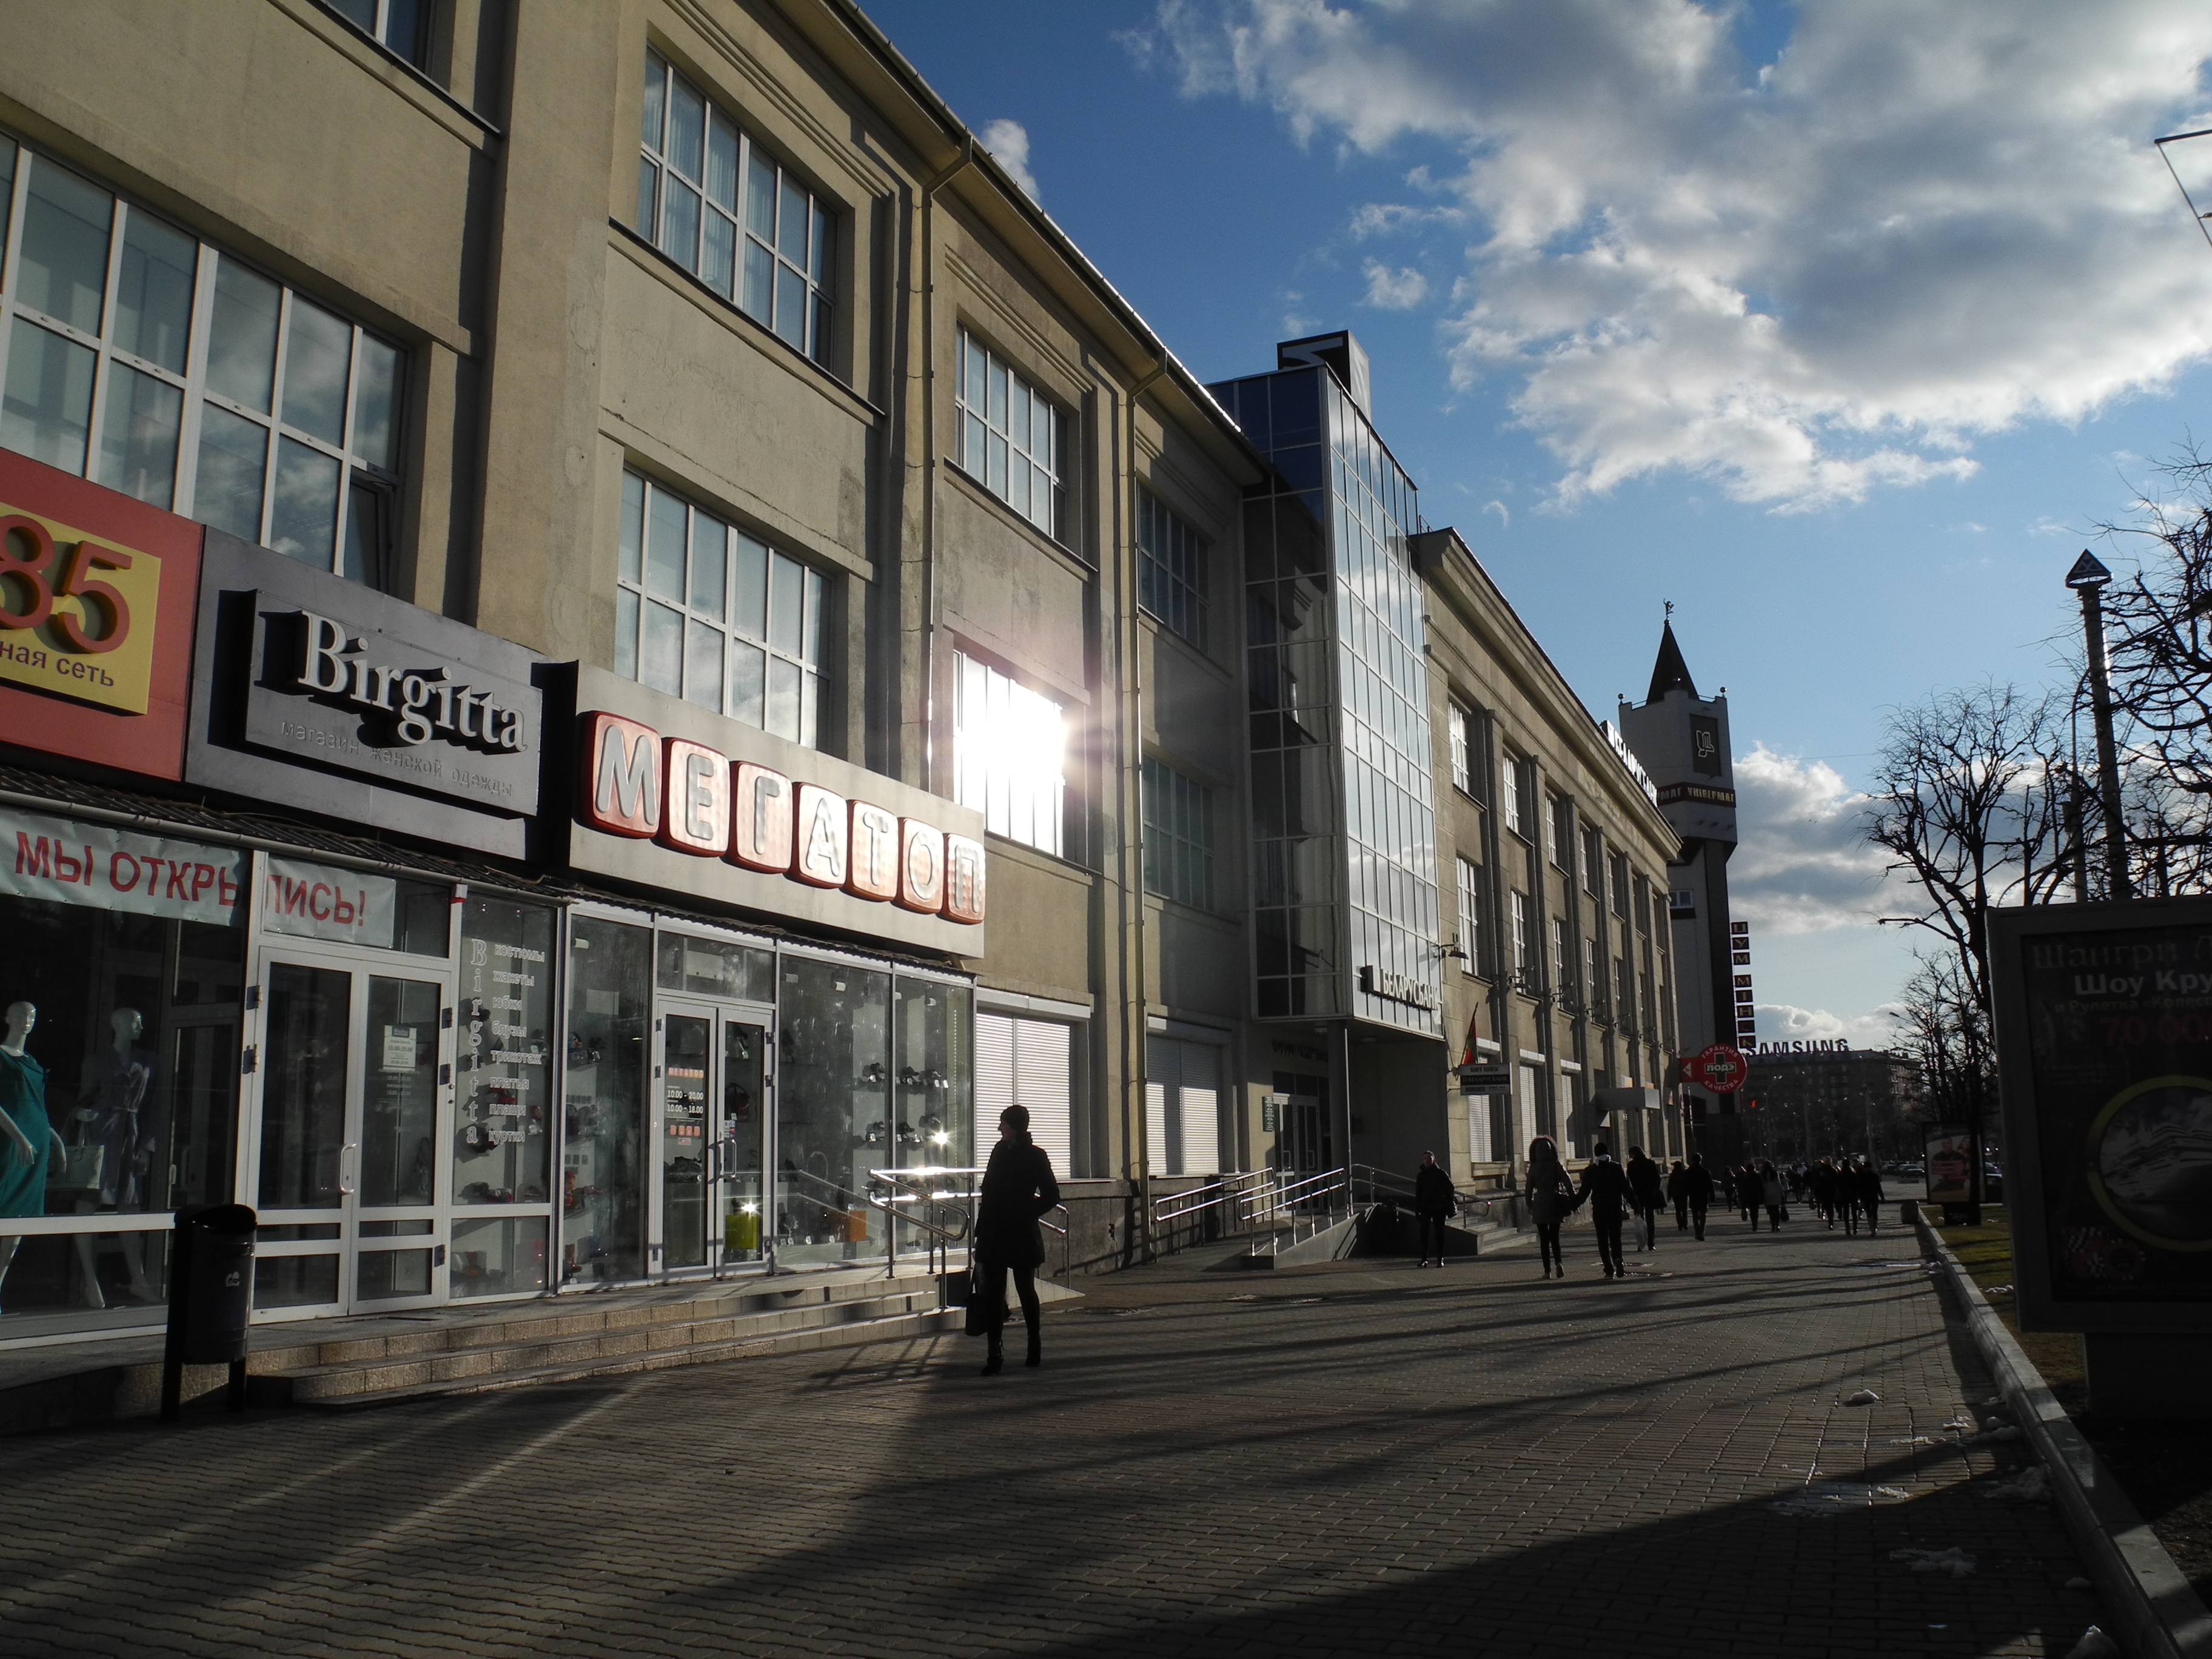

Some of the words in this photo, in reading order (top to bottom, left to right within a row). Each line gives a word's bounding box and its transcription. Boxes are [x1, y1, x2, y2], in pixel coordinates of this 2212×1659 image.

[0, 514, 132, 653] 85
[56, 657, 114, 687] сеть
[298, 609, 528, 752] Birgitta
[282, 720, 360, 756] магазин
[370, 746, 443, 778] женской
[451, 768, 512, 797] одежды
[1687, 786, 1735, 803] УНІВЕРМАГ
[595, 723, 980, 914] МЕГАТОП
[15, 831, 92, 886] МЫ
[1733, 923, 1749, 963] ЦУМ
[494, 943, 545, 963] костюмы
[2033, 943, 2177, 970] Шангри
[492, 971, 535, 987] жакеты
[2074, 973, 2145, 997] Шоу
[1382, 970, 1439, 1011] БЕЛАРУСБАНК
[492, 995, 522, 1011] юбки
[2068, 1000, 2139, 1016] Рулетка
[491, 1020, 528, 1039] блузы
[2097, 1015, 2147, 1047] 70
[466, 938, 488, 1144] Birgitta
[1744, 1038, 1849, 1057] SAMSUNG
[490, 1050, 542, 1065] трикотаж
[1701, 1045, 1738, 1059] ГАРАНТИЯ
[668, 1067, 704, 1079] МЕГАТОП
[489, 1077, 530, 1090] платья
[1704, 1079, 1738, 1091] КАЧЕСТВА
[667, 1090, 683, 1099] 10.00
[689, 1091, 704, 1101] 20.00
[489, 1103, 526, 1118] плащи
[667, 1104, 683, 1113] 10.00
[688, 1105, 704, 1114] 18.00
[488, 1130, 526, 1145] куртки
